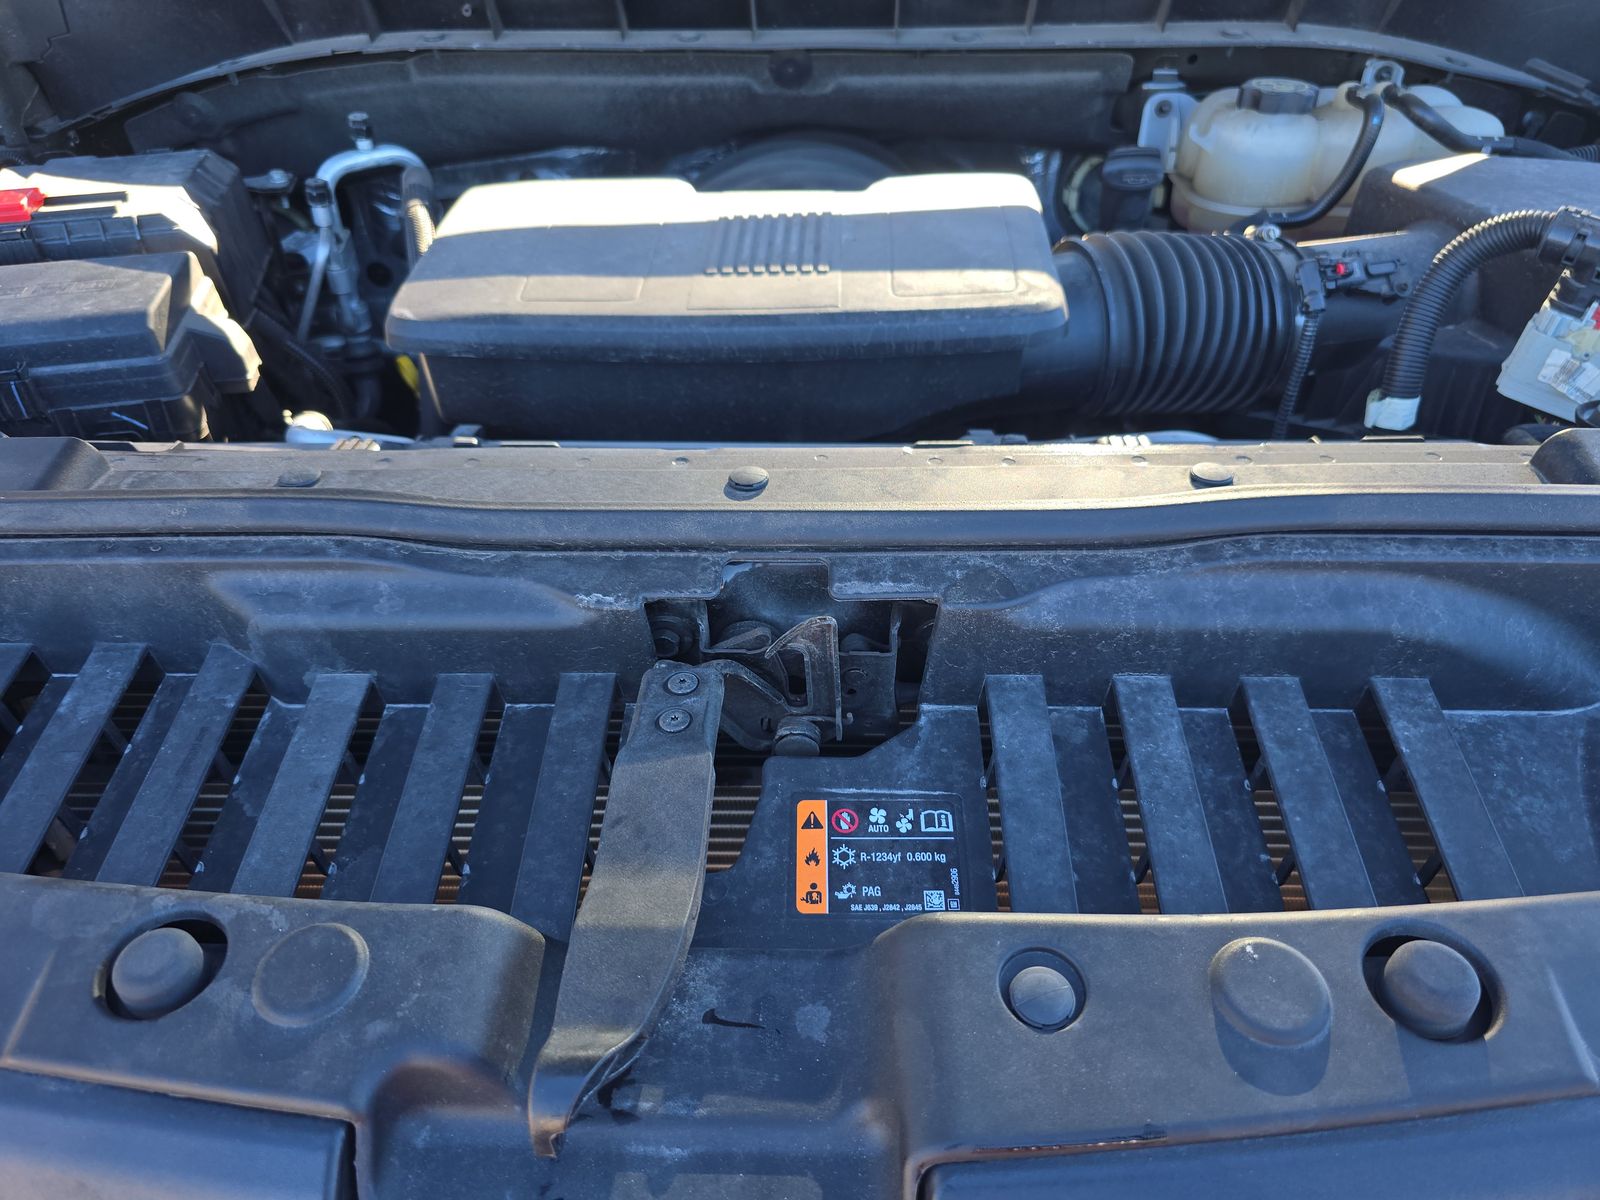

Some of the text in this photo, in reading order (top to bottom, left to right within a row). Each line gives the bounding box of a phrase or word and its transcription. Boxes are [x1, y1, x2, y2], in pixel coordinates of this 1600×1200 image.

[868, 824, 889, 833] AUTO
[860, 852, 946, 863] R-1234yf 0.600 kg
[862, 886, 881, 897] PAG
[850, 903, 863, 911] SAE
